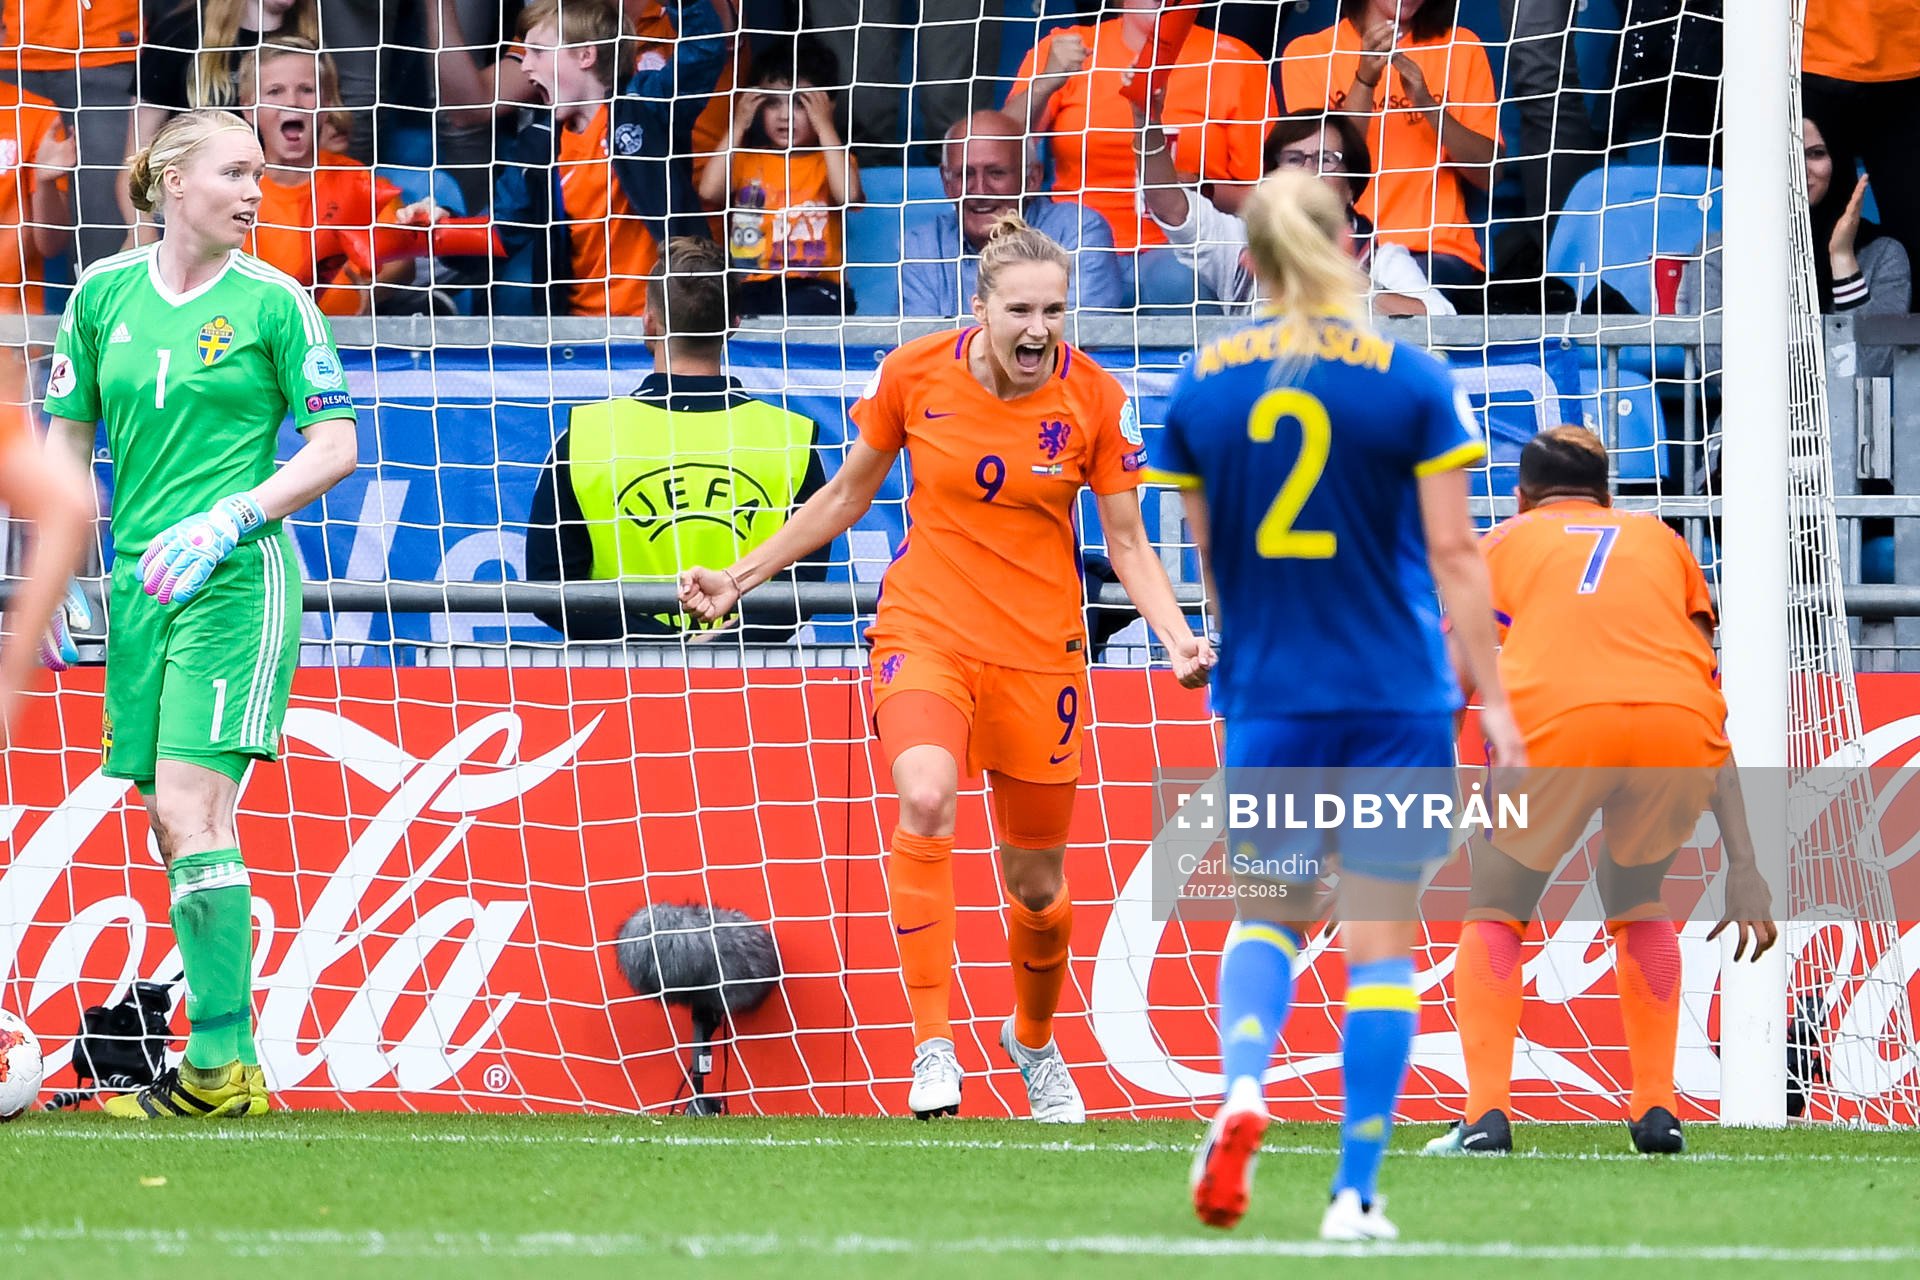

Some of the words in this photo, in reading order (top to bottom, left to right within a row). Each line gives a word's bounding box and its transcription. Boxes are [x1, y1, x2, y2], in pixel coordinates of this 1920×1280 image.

[155, 349, 172, 409] 1
[1194, 324, 1396, 381] ANDESON
[975, 455, 1006, 502] 9
[1247, 387, 1337, 559] 2
[624, 476, 760, 532] UEFA
[1563, 524, 1621, 594] 7
[210, 679, 227, 742] 1
[1057, 685, 1077, 745] 9
